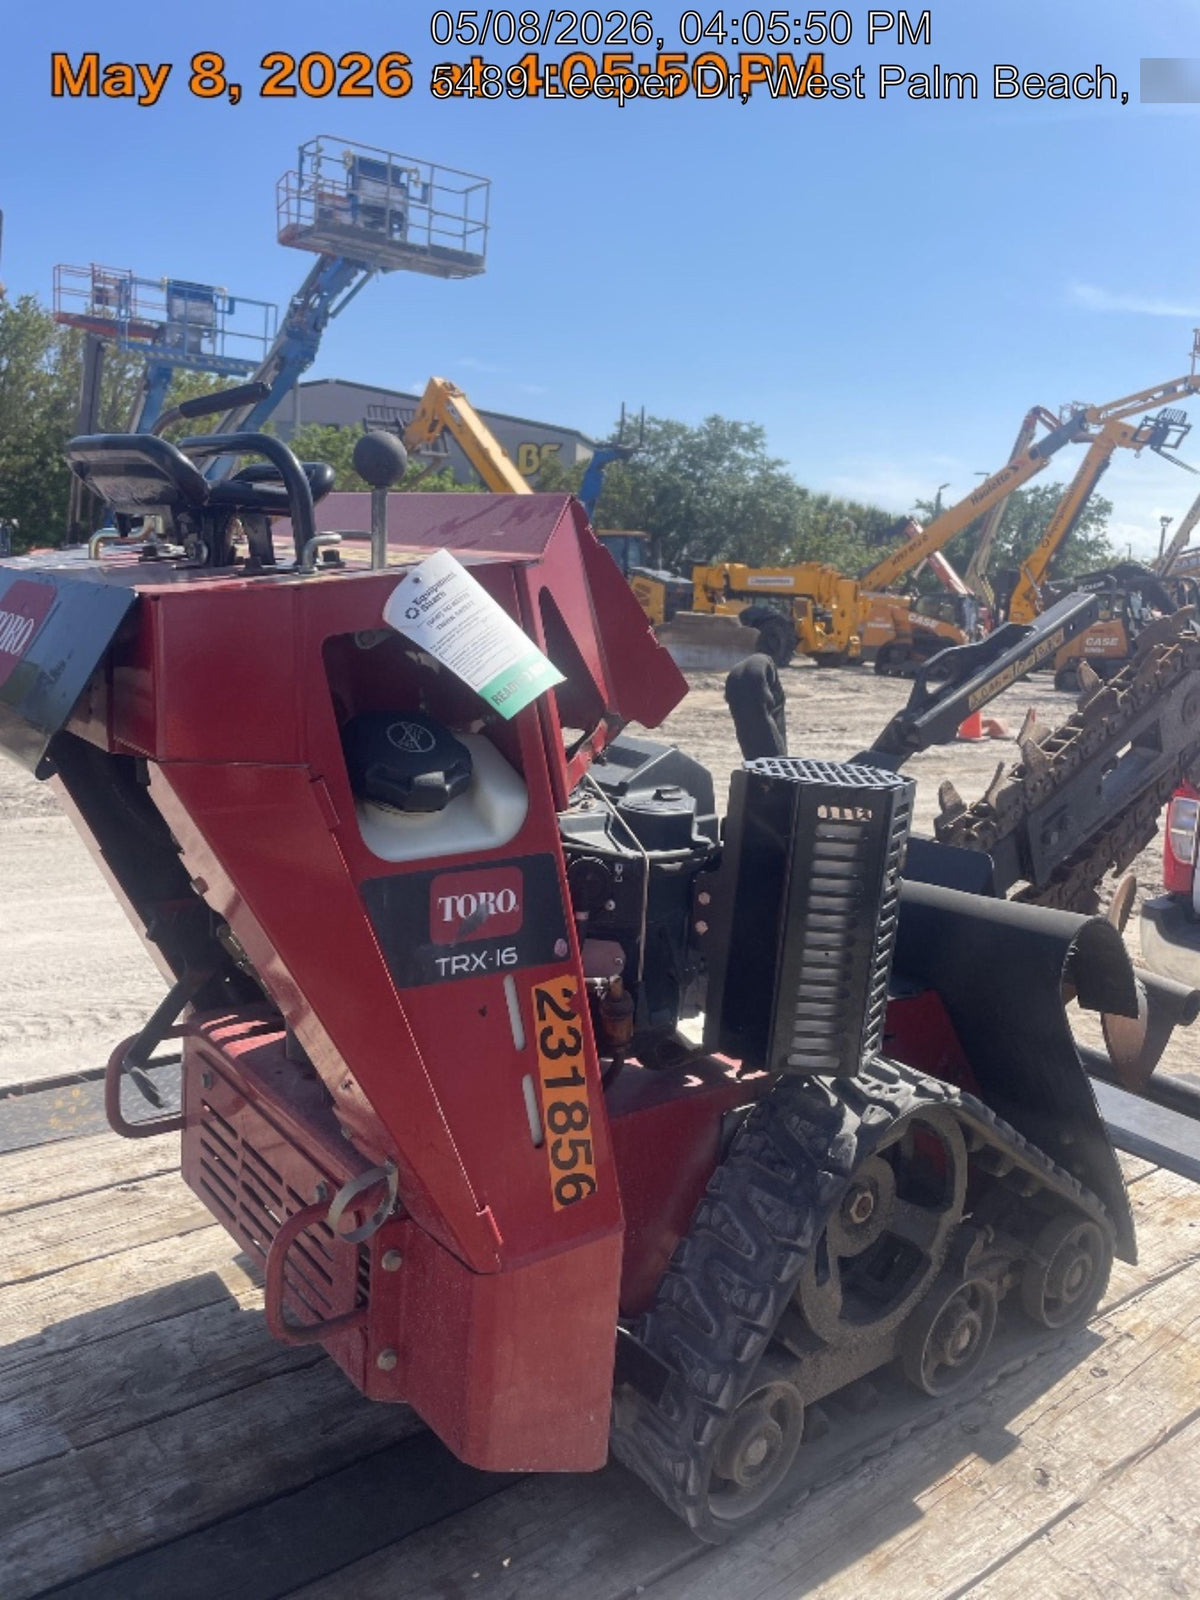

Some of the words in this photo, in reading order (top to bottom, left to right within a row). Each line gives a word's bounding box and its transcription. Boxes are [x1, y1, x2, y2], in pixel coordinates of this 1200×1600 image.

[908, 612, 939, 628] CASE
[1085, 637, 1119, 646] CASE
[437, 889, 517, 922] TORO
[435, 946, 519, 977] TRX-16
[534, 987, 597, 1207] 231856
